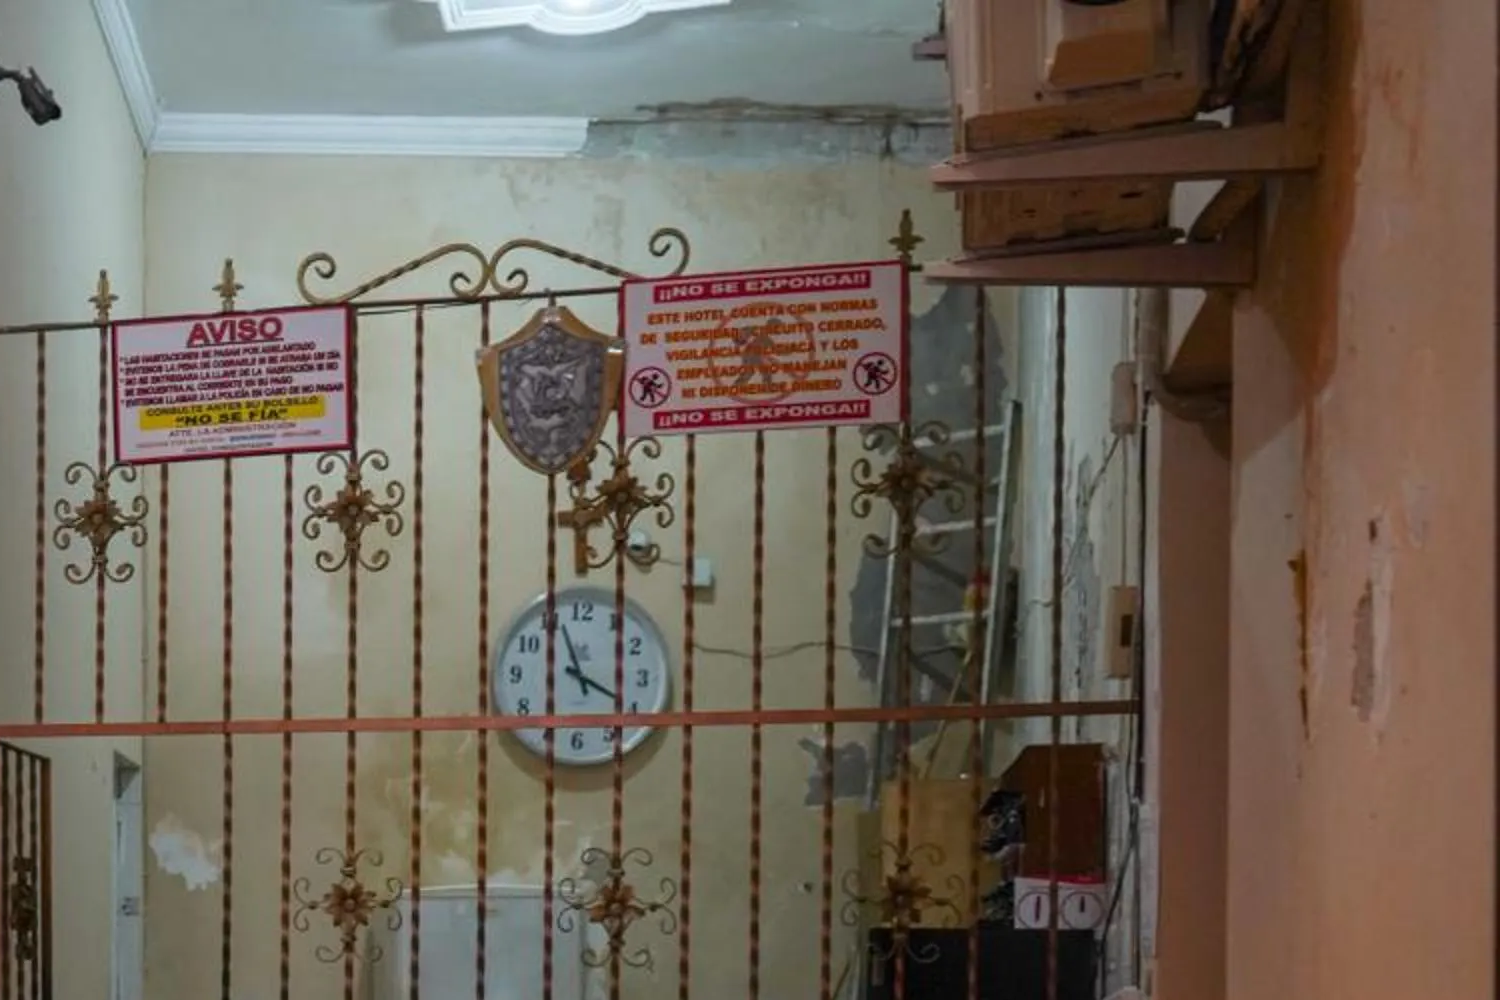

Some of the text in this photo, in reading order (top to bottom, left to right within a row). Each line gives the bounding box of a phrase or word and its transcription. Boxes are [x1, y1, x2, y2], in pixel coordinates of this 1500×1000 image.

[710, 281, 740, 295] SE
[744, 274, 868, 293] EXPONGA!!
[648, 299, 878, 324] ESTE HOTEL CUENTA CON NORMAS
[187, 317, 283, 345] AVISO
[640, 332, 656, 344] DE
[818, 318, 886, 335] CERRADO,
[820, 340, 828, 351] Y
[832, 339, 858, 350] LOS
[238, 369, 250, 377] DE
[250, 368, 262, 376] LA
[790, 378, 842, 392] DINERO
[244, 400, 260, 409] SU
[264, 396, 318, 407] BOLSILLO
[710, 409, 739, 422] SE
[744, 401, 868, 420] EXPONGA!!
[218, 412, 242, 423] SE
[571, 602, 594, 621] 12
[518, 635, 540, 653] 10
[629, 638, 642, 656] 2
[510, 665, 522, 684] 9
[637, 669, 649, 688] 3
[517, 698, 529, 716] 8
[570, 731, 584, 750] 6
